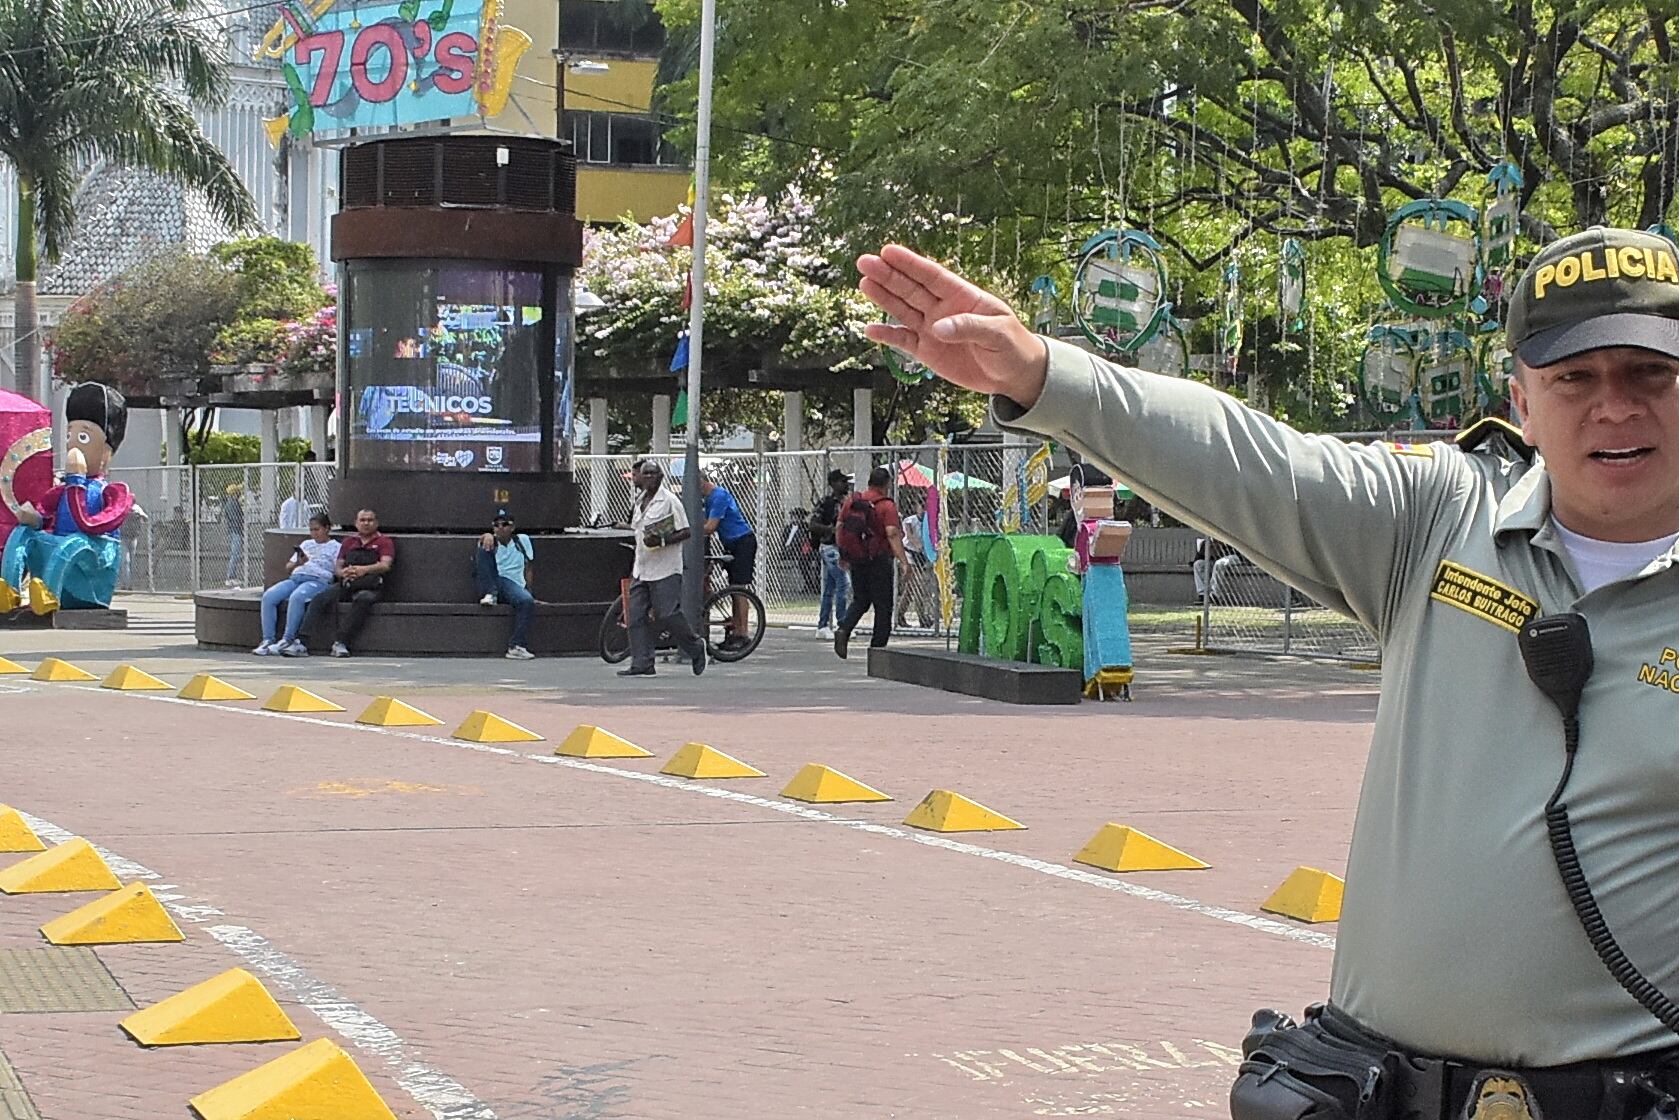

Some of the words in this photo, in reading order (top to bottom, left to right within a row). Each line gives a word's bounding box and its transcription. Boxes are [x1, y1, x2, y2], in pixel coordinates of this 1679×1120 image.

[294, 19, 478, 107] 70's
[1535, 246, 1679, 299] POLICIA
[1436, 580, 1473, 603] CARLOS
[1472, 593, 1525, 628] BUITRAGO
[1443, 566, 1502, 600] Intendente
